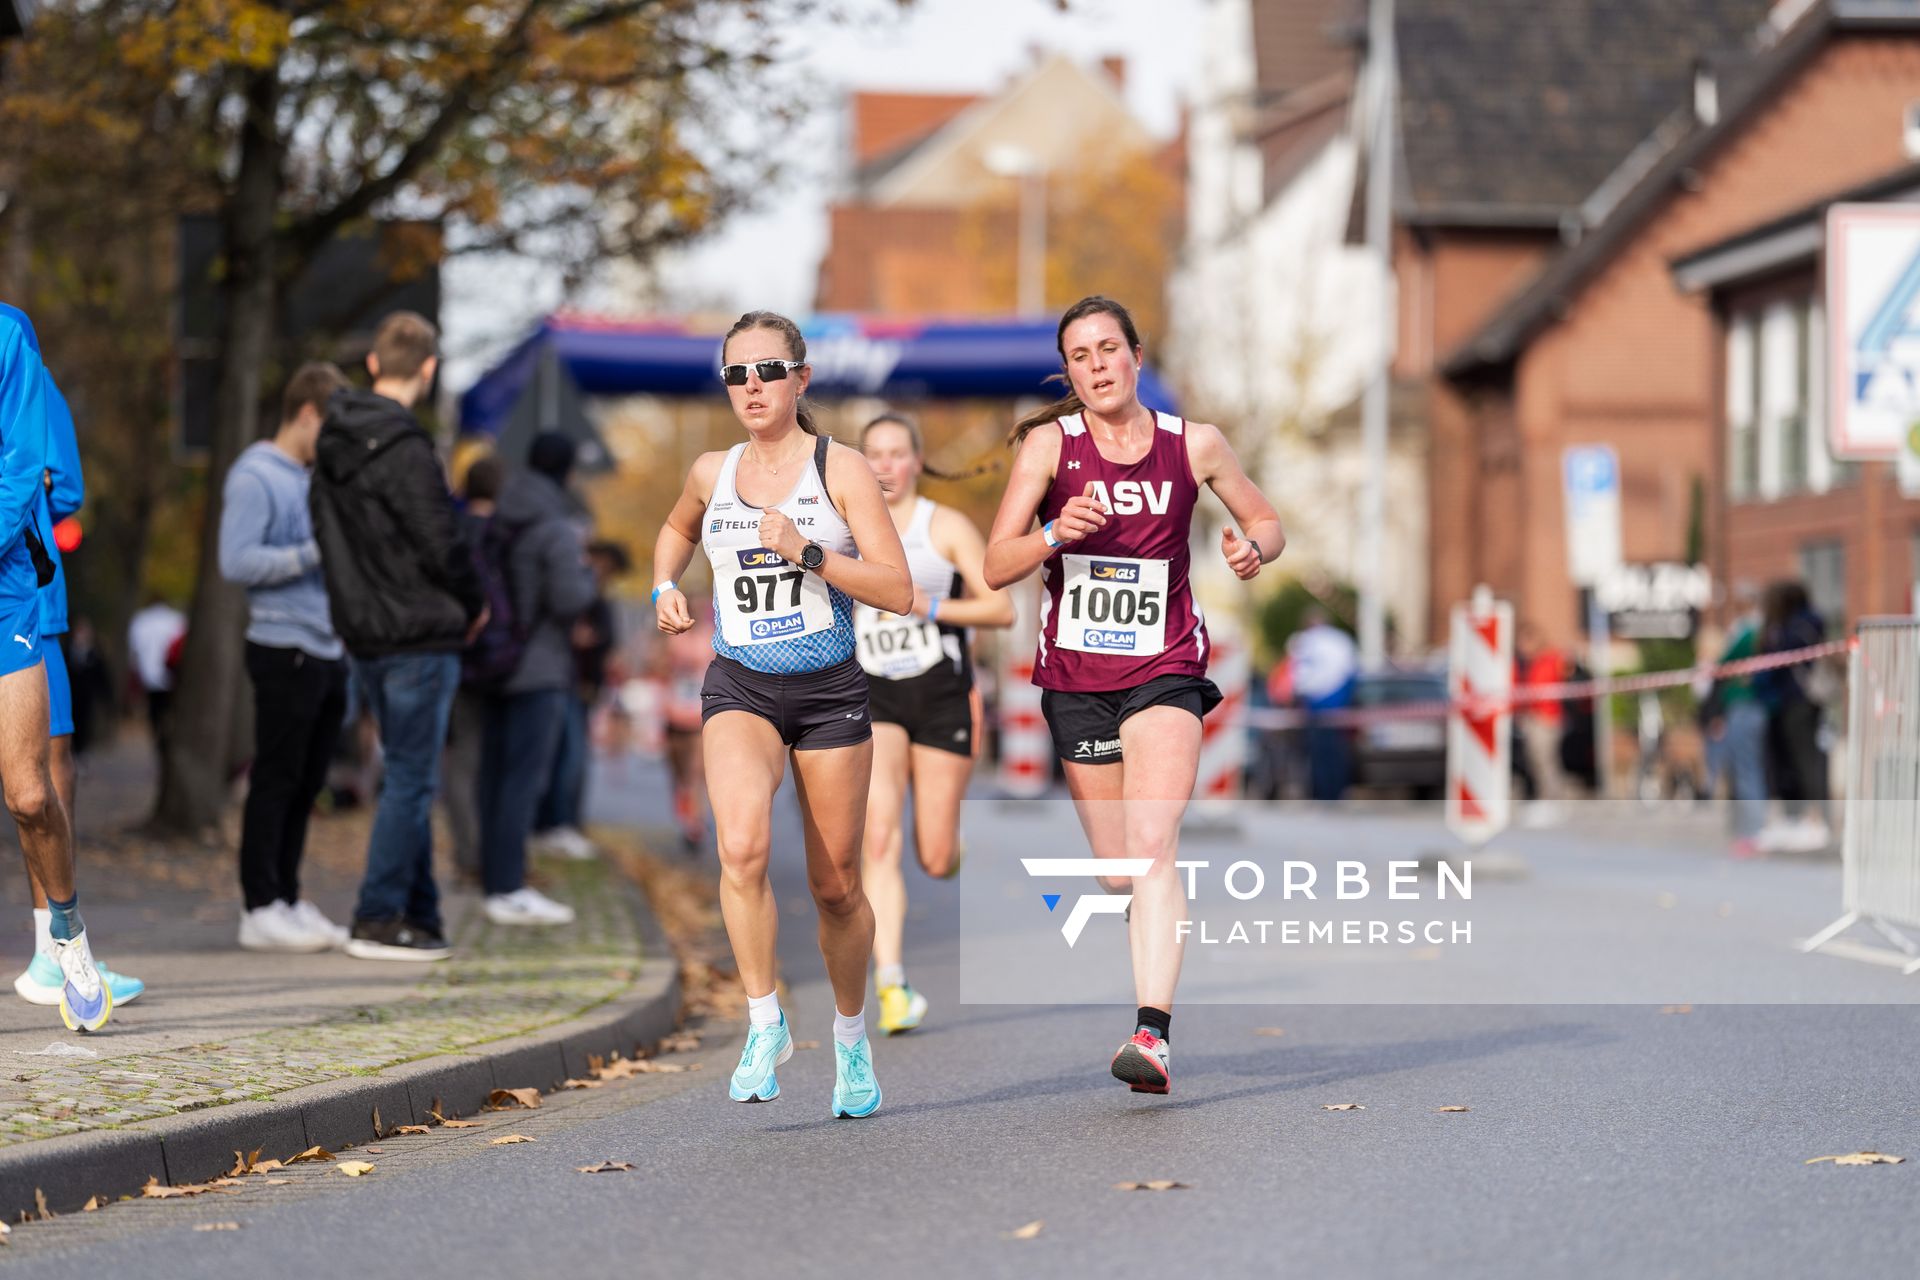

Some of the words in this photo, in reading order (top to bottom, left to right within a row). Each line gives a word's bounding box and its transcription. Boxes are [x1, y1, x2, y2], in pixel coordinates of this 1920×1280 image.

[1089, 480, 1173, 515] ASV
[725, 520, 759, 530] TELIS
[765, 553, 783, 564] GLS
[1115, 568, 1137, 580] GLS
[734, 570, 805, 613] 977
[1068, 585, 1160, 626] 1005
[771, 616, 802, 631] PLAN
[863, 624, 929, 657] 1021
[1104, 633, 1135, 645] PLAN
